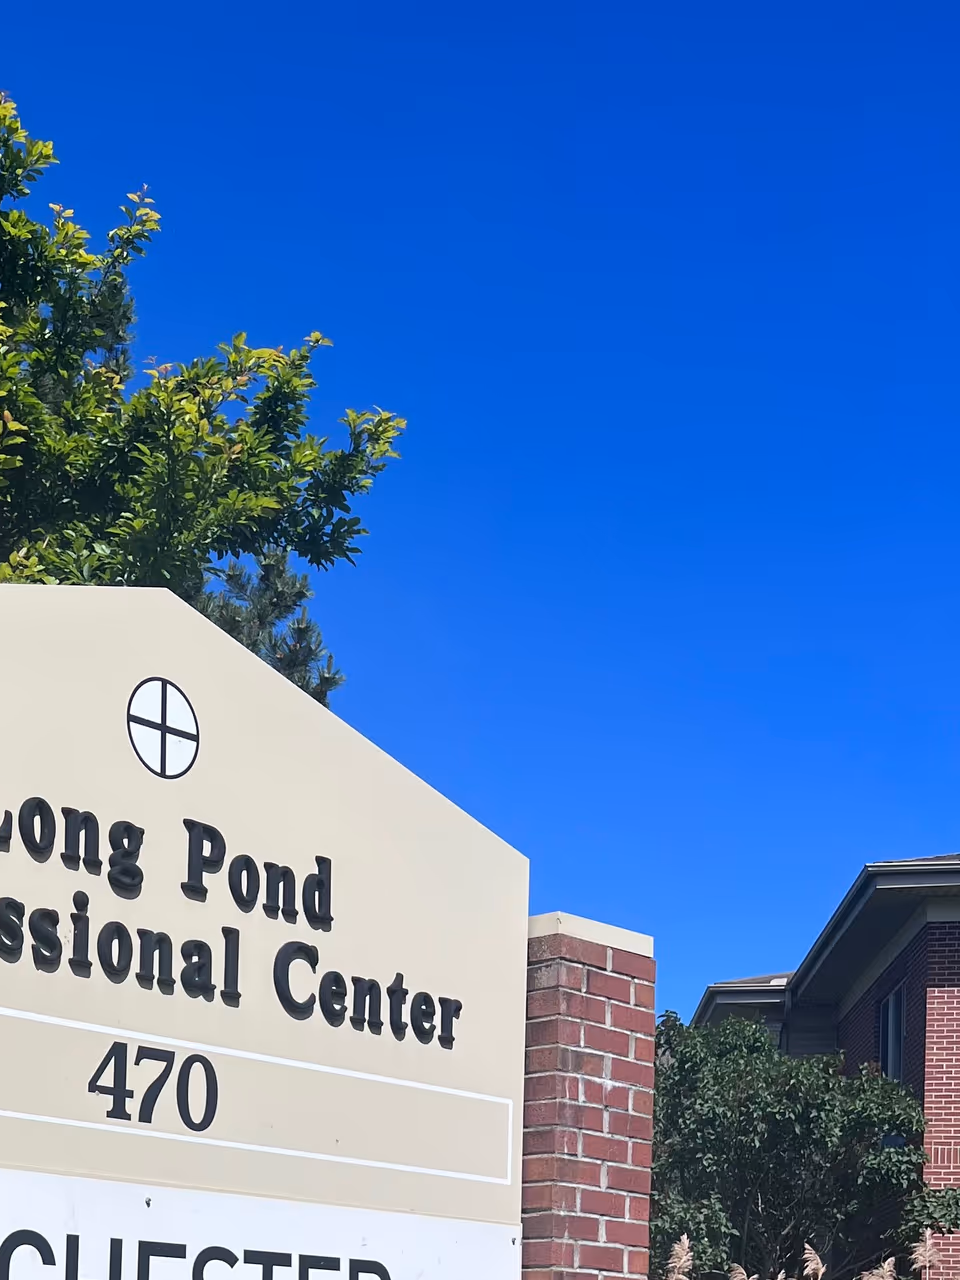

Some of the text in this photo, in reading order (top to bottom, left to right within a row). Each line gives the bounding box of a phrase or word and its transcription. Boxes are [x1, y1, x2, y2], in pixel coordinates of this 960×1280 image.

[181, 819, 334, 931] Pond
[273, 941, 463, 1049] Center
[88, 1042, 218, 1131] 470
